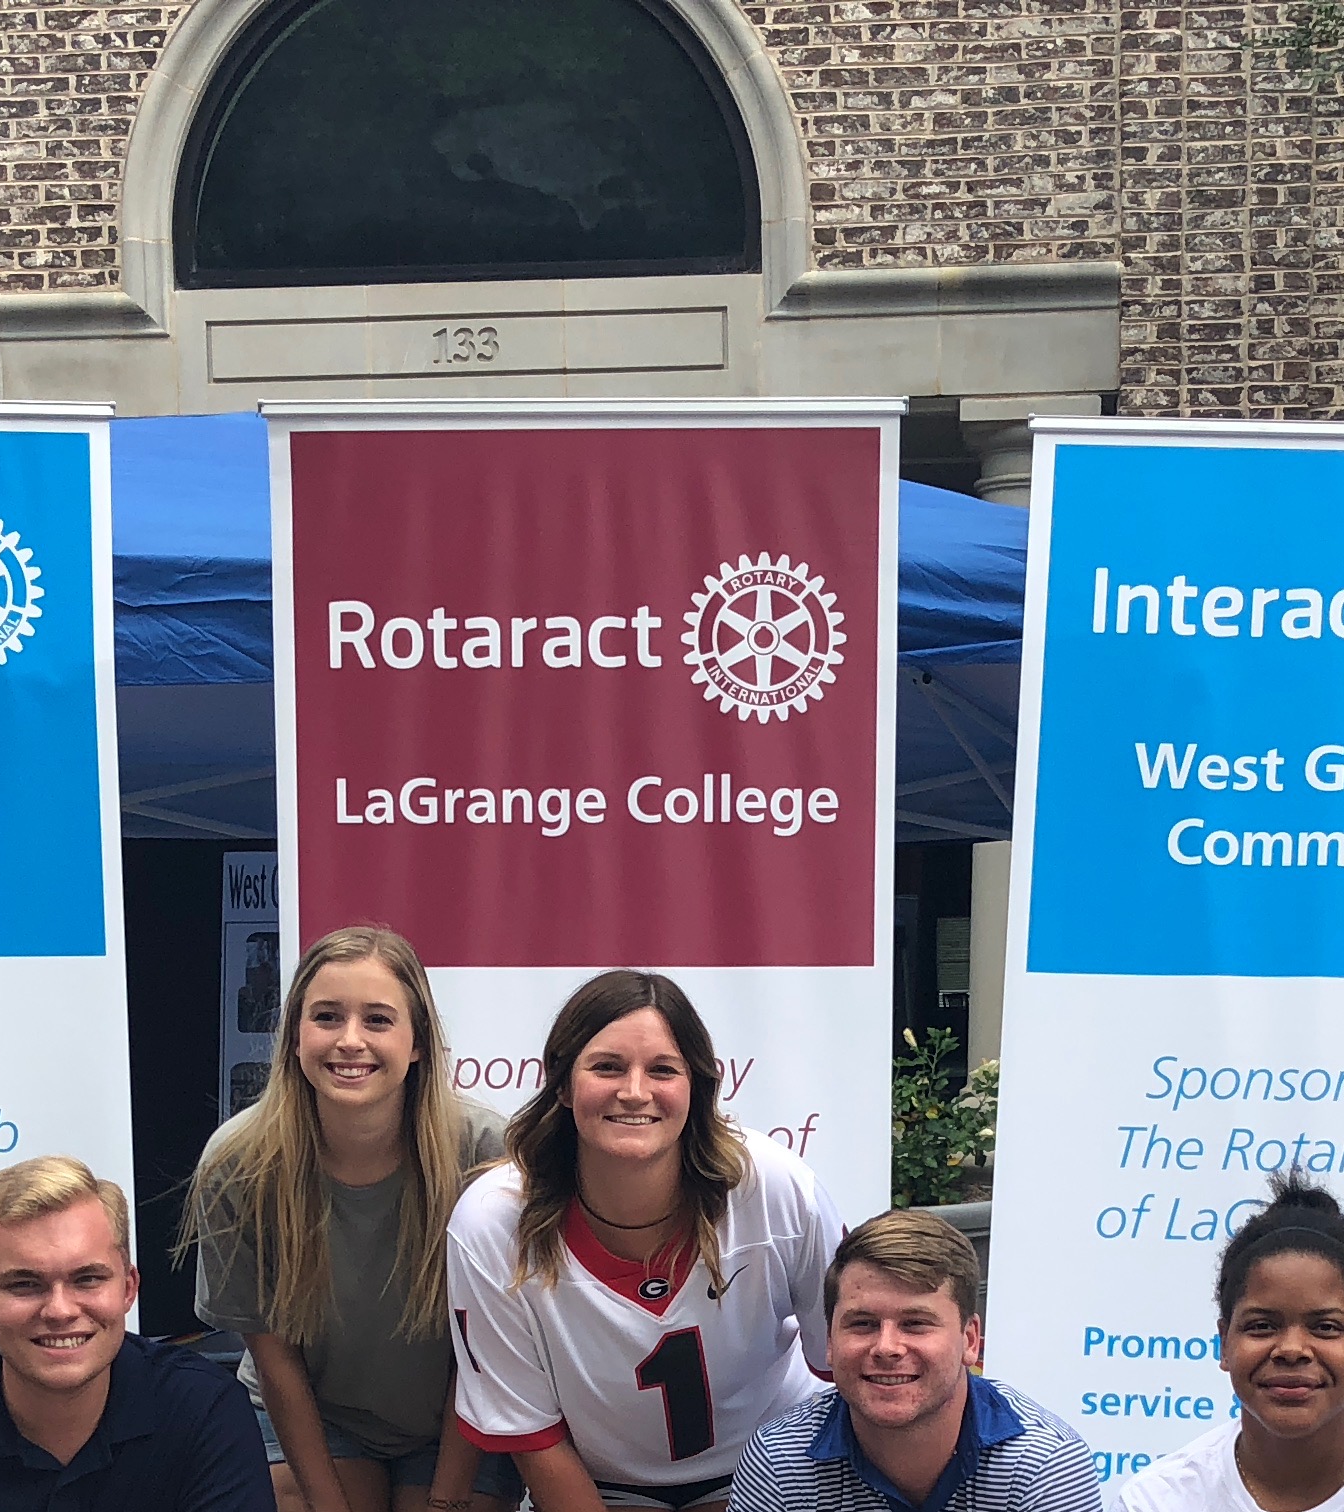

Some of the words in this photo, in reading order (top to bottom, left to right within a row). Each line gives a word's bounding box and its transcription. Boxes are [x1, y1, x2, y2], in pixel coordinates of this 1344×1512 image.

[432, 326, 500, 363] 133
[730, 571, 800, 592] ROTARY
[329, 600, 662, 670] Rotaract
[708, 663, 823, 706] INTERNATIONAL
[1135, 742, 1285, 792] West
[336, 777, 607, 837] LaGrange
[627, 774, 839, 837] College
[229, 864, 267, 909] West
[1118, 1123, 1206, 1172] The
[1096, 1192, 1155, 1240] of
[1083, 1325, 1222, 1362] Promot
[634, 1326, 716, 1461] 1
[1080, 1386, 1215, 1420] service
